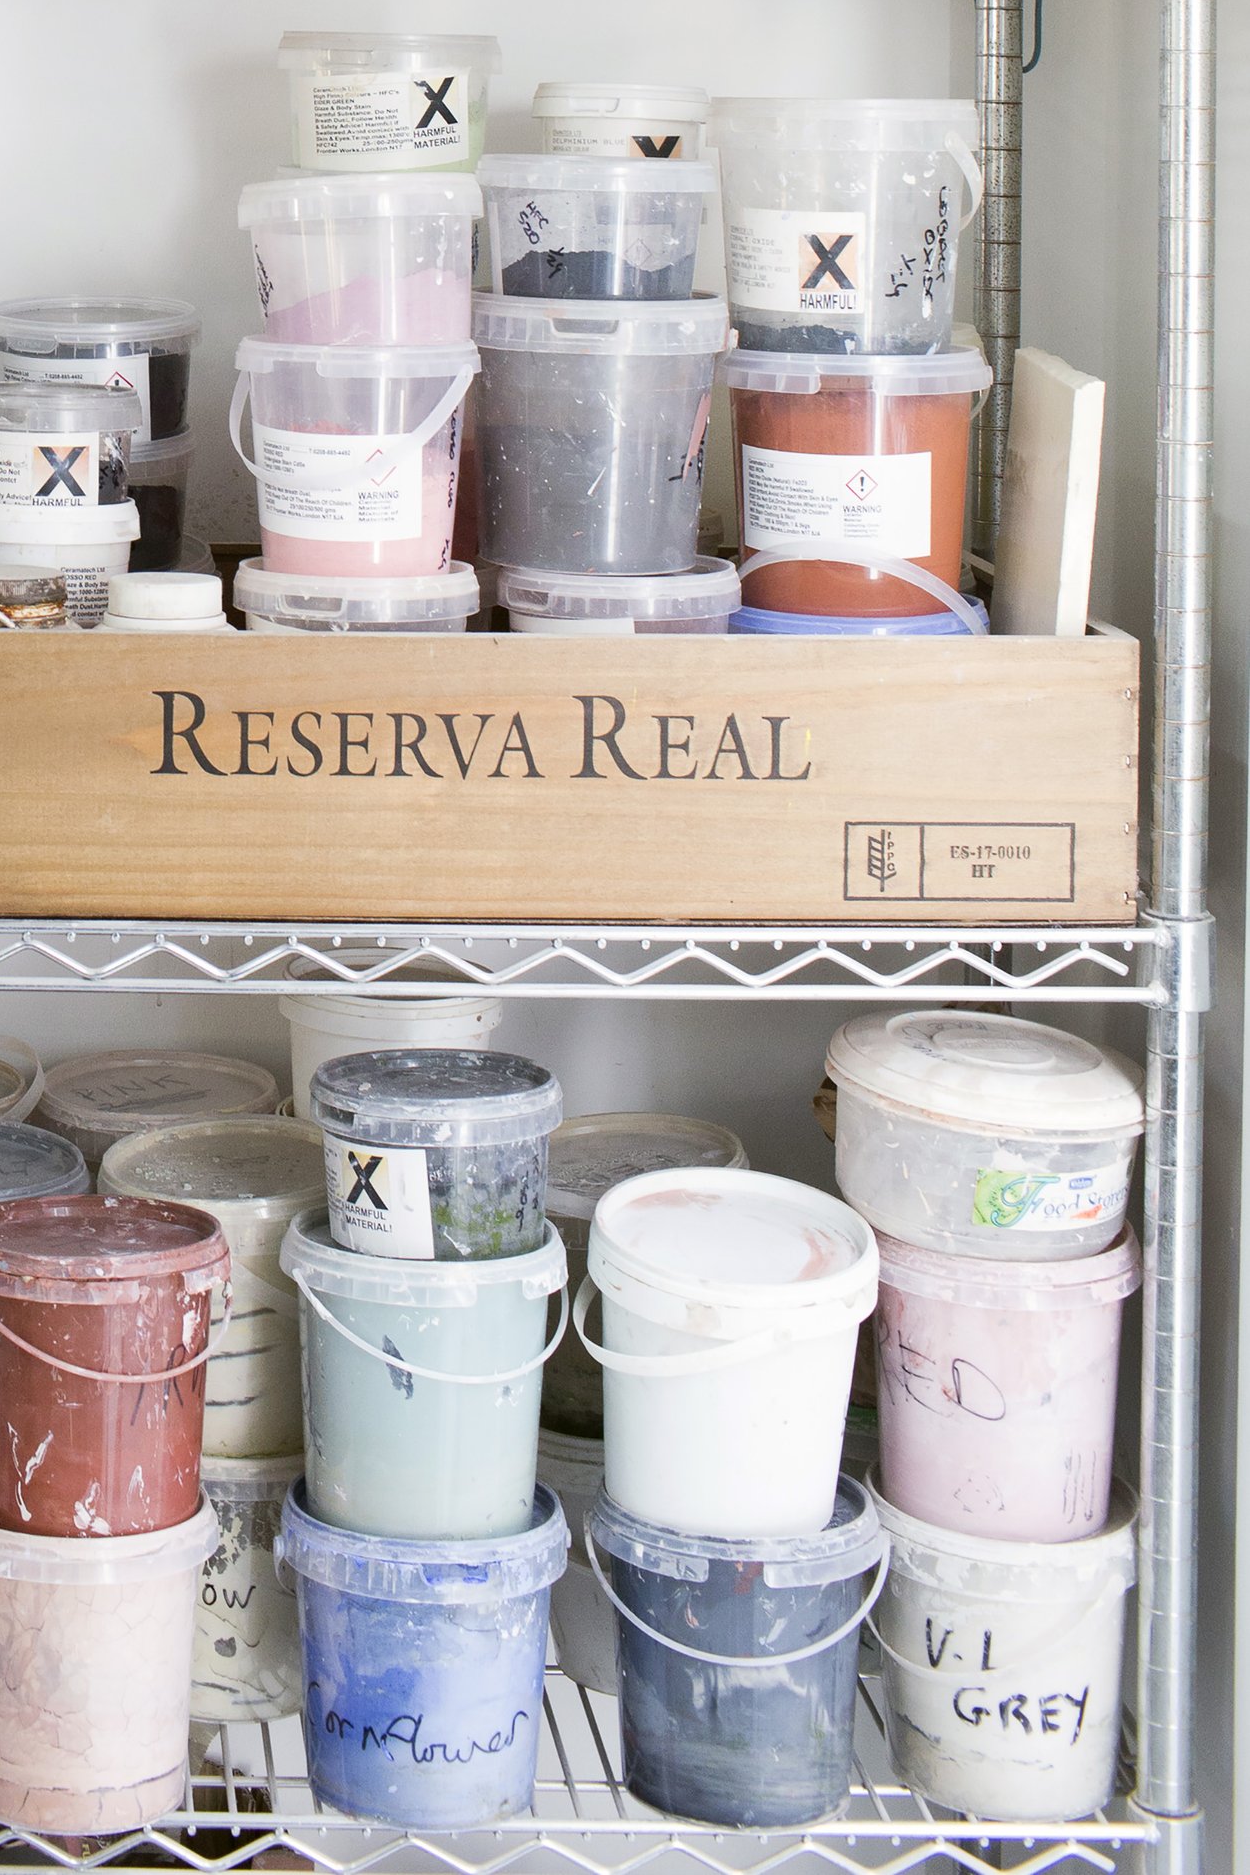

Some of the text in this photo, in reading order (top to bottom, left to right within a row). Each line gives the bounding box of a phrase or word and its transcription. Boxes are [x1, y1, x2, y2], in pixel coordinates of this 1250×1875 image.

[413, 125, 456, 139] HARMFUL
[800, 293, 857, 310] HARMFUL!
[358, 490, 399, 500] WARNING
[32, 498, 84, 507] HARMFUL
[843, 505, 882, 514] WARNING
[950, 845, 1031, 860] ES-17-0010
[971, 864, 996, 878] HT
[345, 1203, 387, 1221] HARMFUL
[953, 1684, 1090, 1747] GREY
